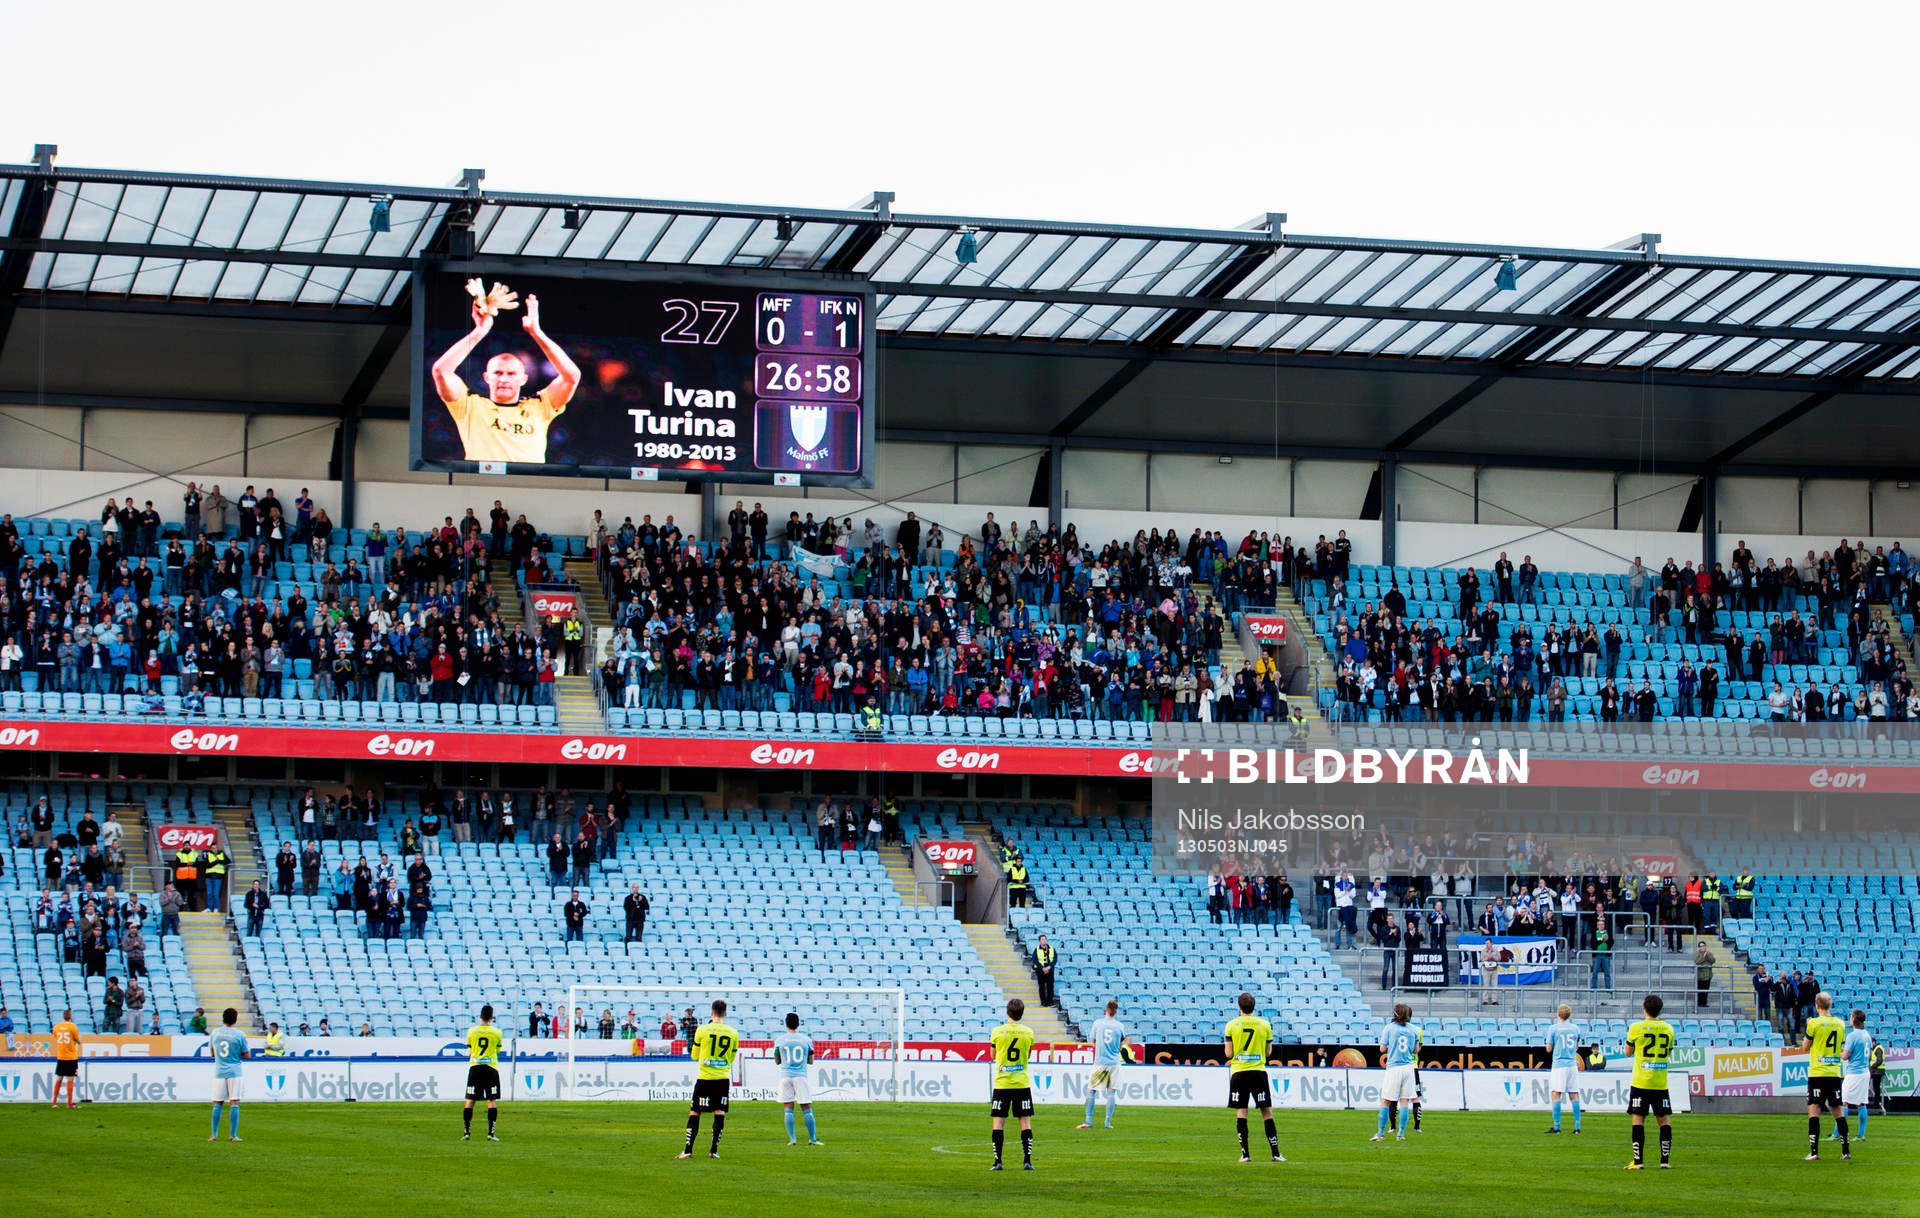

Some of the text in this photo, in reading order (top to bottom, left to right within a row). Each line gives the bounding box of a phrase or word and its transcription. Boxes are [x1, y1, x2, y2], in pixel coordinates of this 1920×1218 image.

[762, 298, 792, 312] MFF
[820, 301, 857, 315] IFK N
[661, 298, 739, 345] 27
[766, 317, 785, 345] 0
[835, 320, 847, 348] 1
[766, 362, 851, 393] 26:58
[664, 381, 736, 409] Ivan
[627, 408, 736, 437] Turina
[634, 442, 737, 461] 1980-2013
[57, 1032, 71, 1044] 25
[709, 1033, 731, 1058] 19
[1103, 1028, 1113, 1043] 5
[1243, 1028, 1255, 1052] 7
[1398, 1036, 1409, 1053] 8
[1560, 1034, 1574, 1049] 15
[1643, 1033, 1669, 1058] 23
[1825, 1030, 1837, 1053] 4
[219, 1041, 229, 1058] 3
[478, 1037, 488, 1056] 9
[784, 1045, 804, 1063] 10
[1007, 1038, 1020, 1062] 6
[1717, 1054, 1769, 1074] MALMÖ
[297, 1072, 439, 1100] Nätverket
